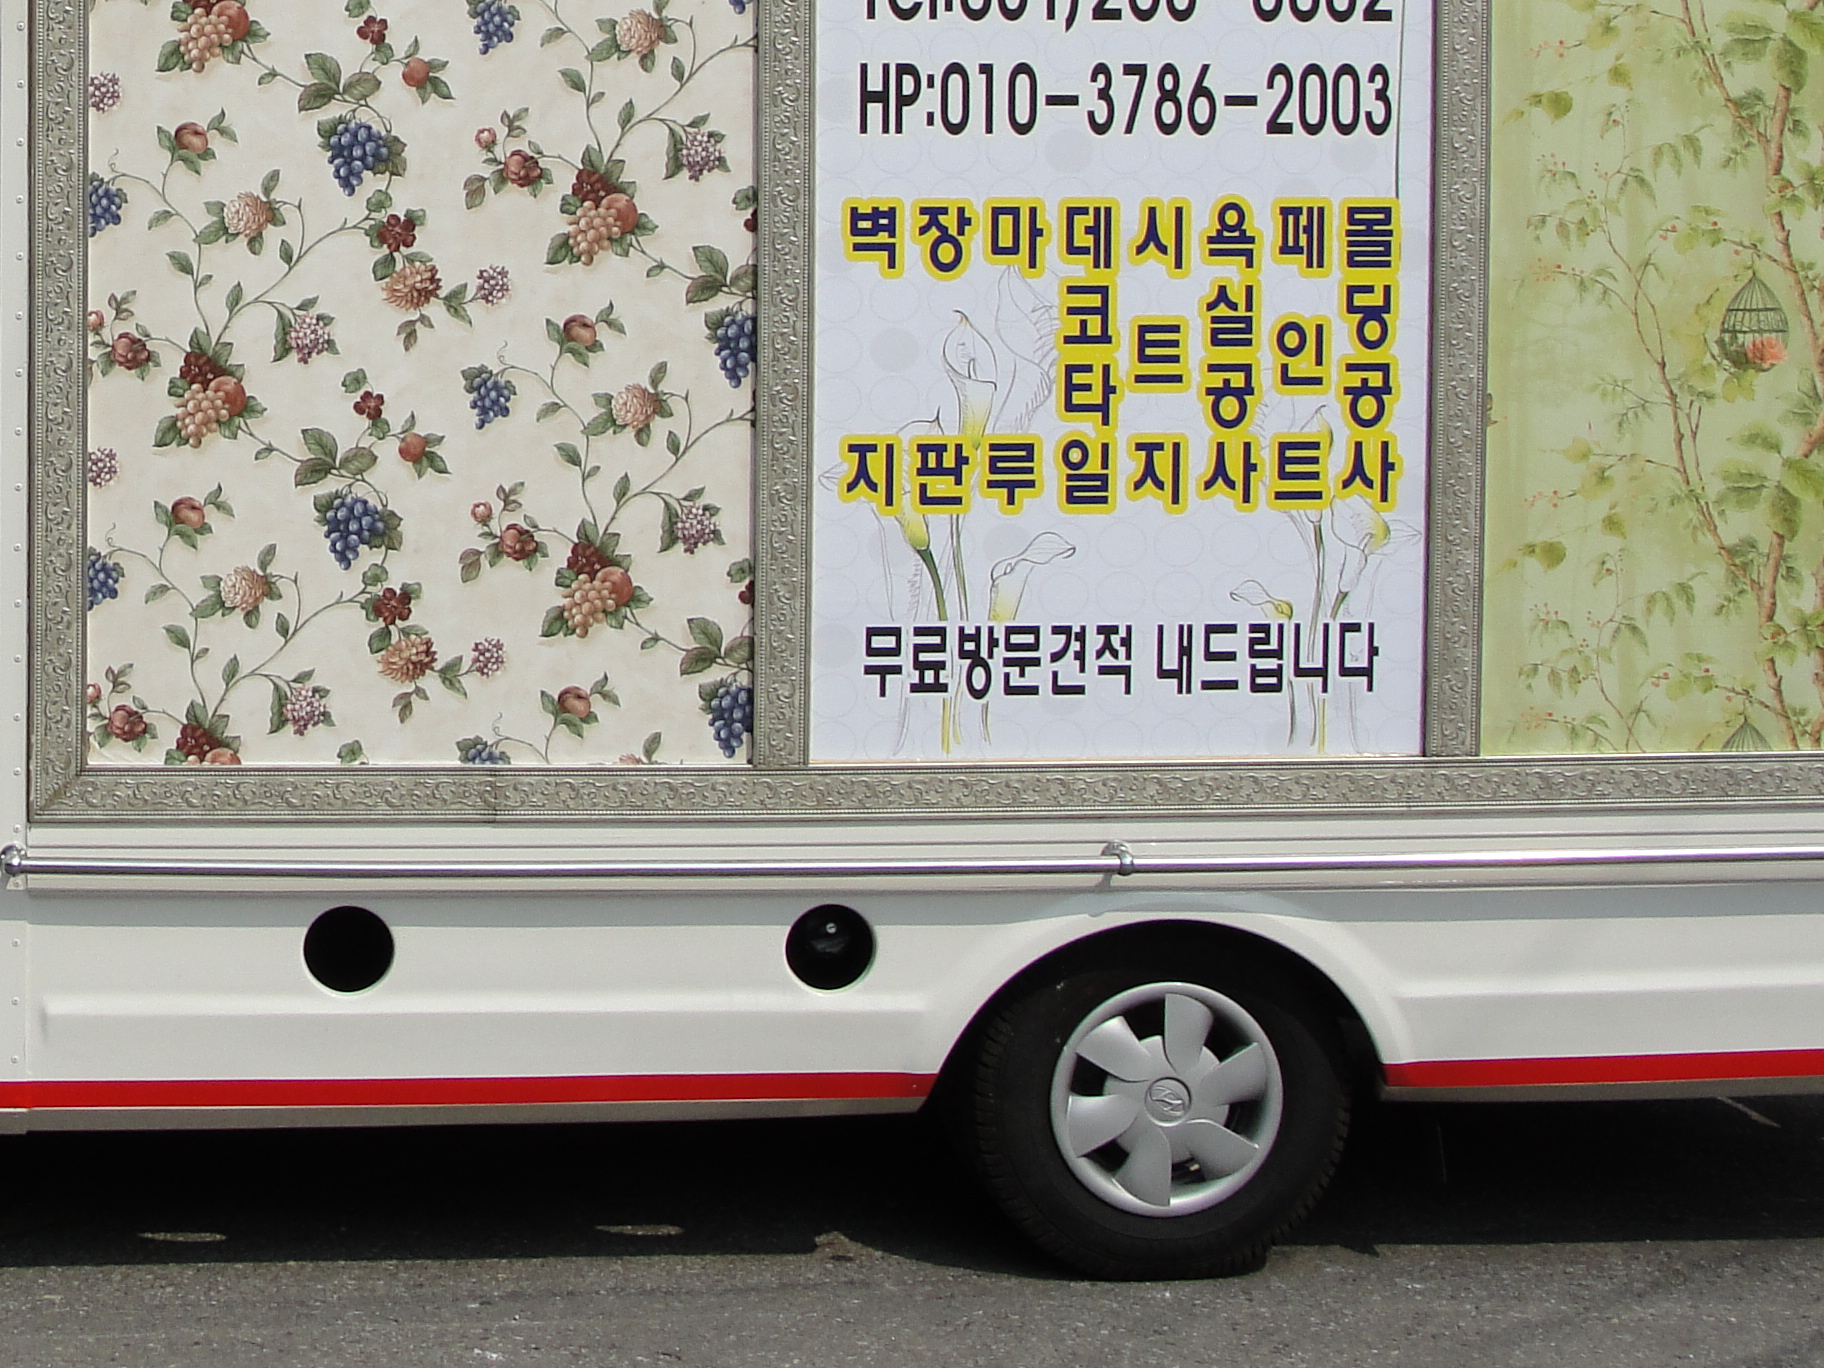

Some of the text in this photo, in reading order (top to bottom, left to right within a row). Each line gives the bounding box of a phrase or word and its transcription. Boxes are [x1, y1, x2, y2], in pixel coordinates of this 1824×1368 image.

[858, 62, 1393, 137] HP:010-3786-2003
[862, 620, 1379, 701] 무료방문견적 내드립니다
